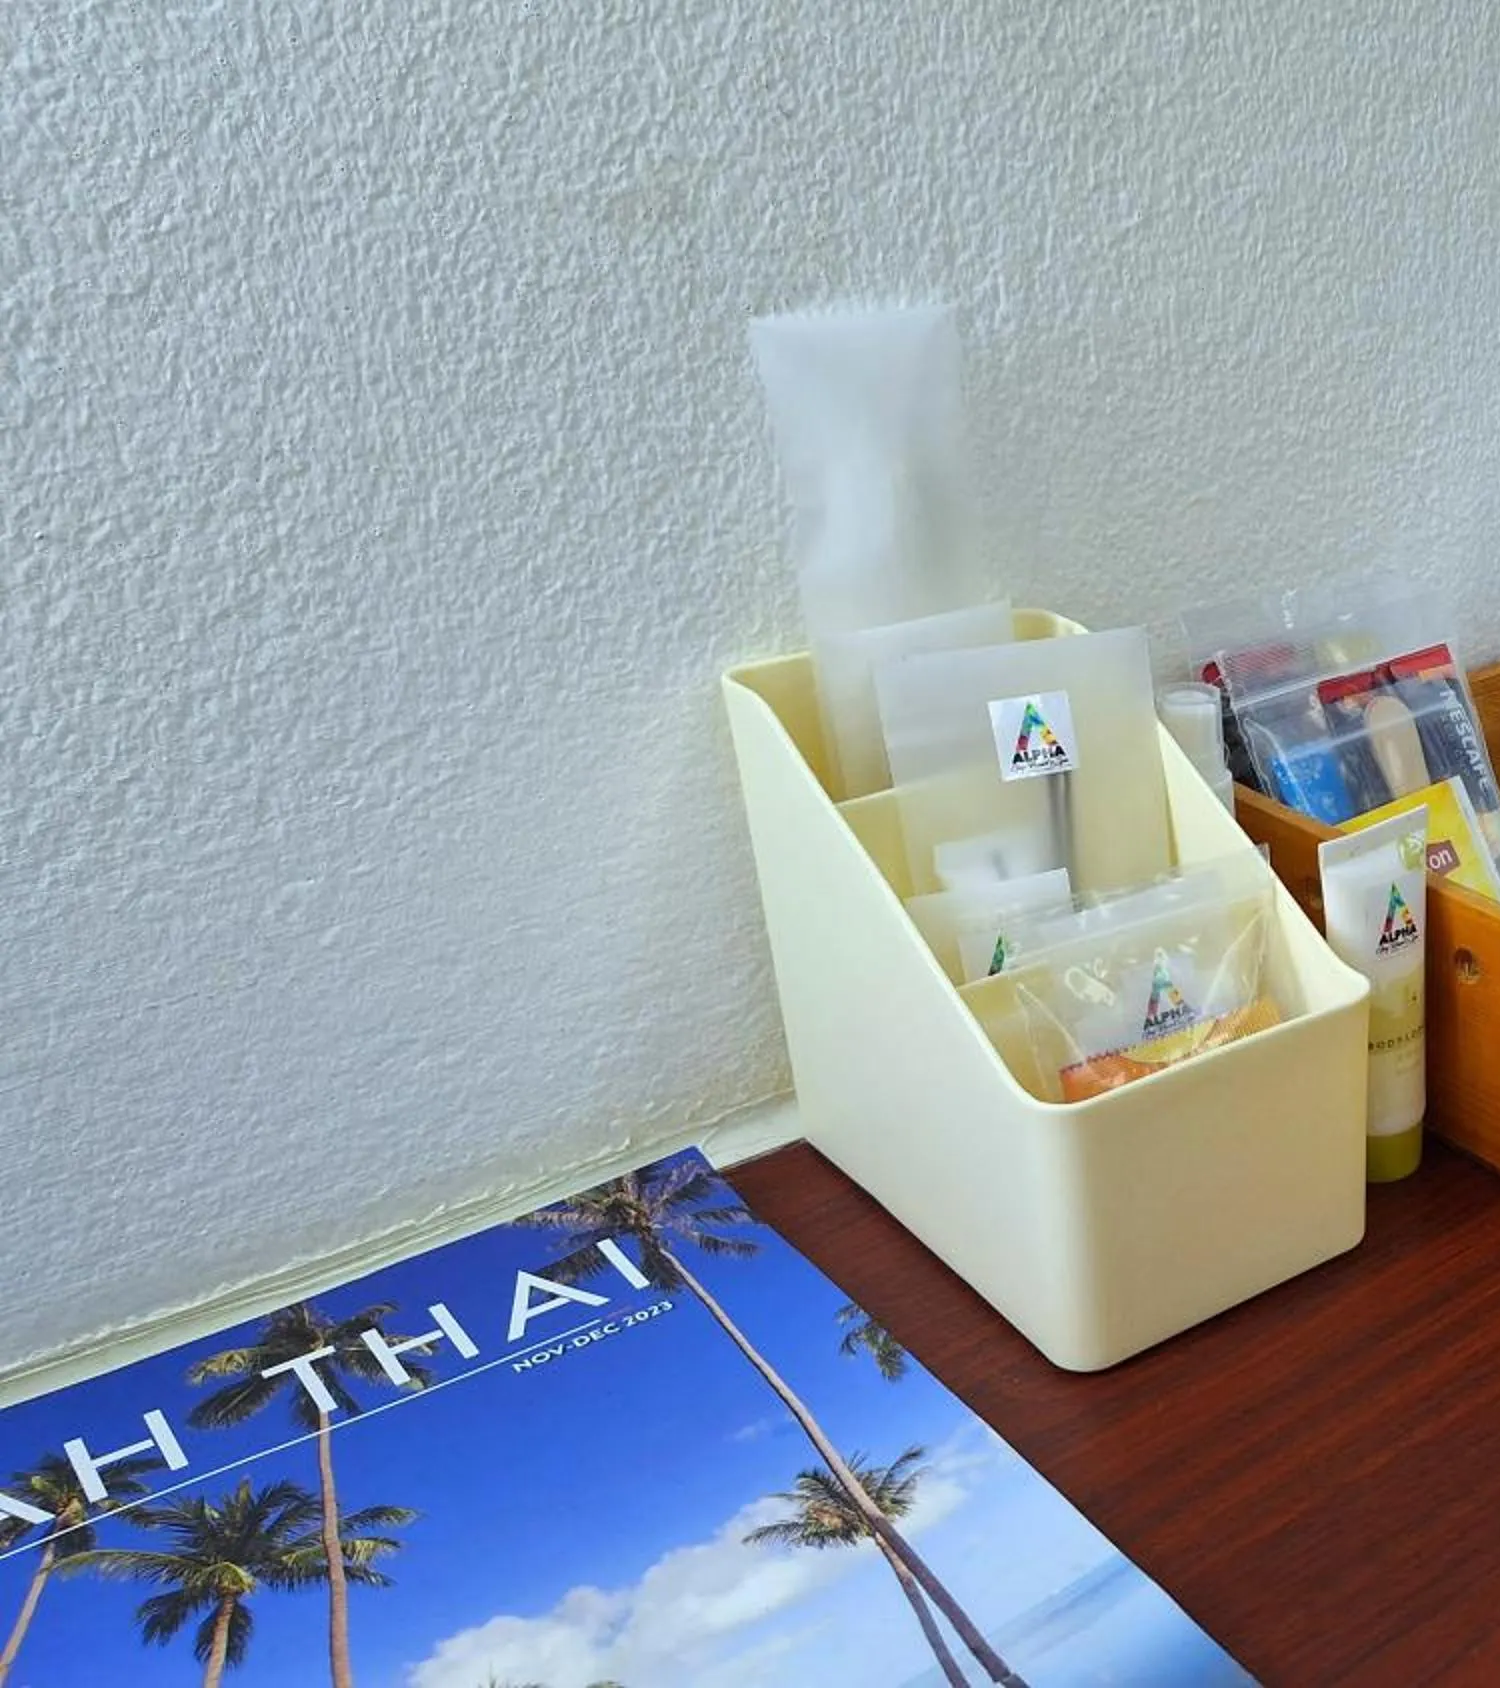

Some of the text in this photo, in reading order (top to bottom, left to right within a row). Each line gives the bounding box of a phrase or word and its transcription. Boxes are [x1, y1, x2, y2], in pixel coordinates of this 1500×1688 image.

[1012, 745, 1067, 765] ALPHA
[1429, 850, 1453, 869] on
[1379, 923, 1417, 947] ALPHA
[1143, 1003, 1195, 1031] ALPHA
[261, 1237, 651, 1412] THAI
[512, 1300, 674, 1373] NOV-DEC 2023
